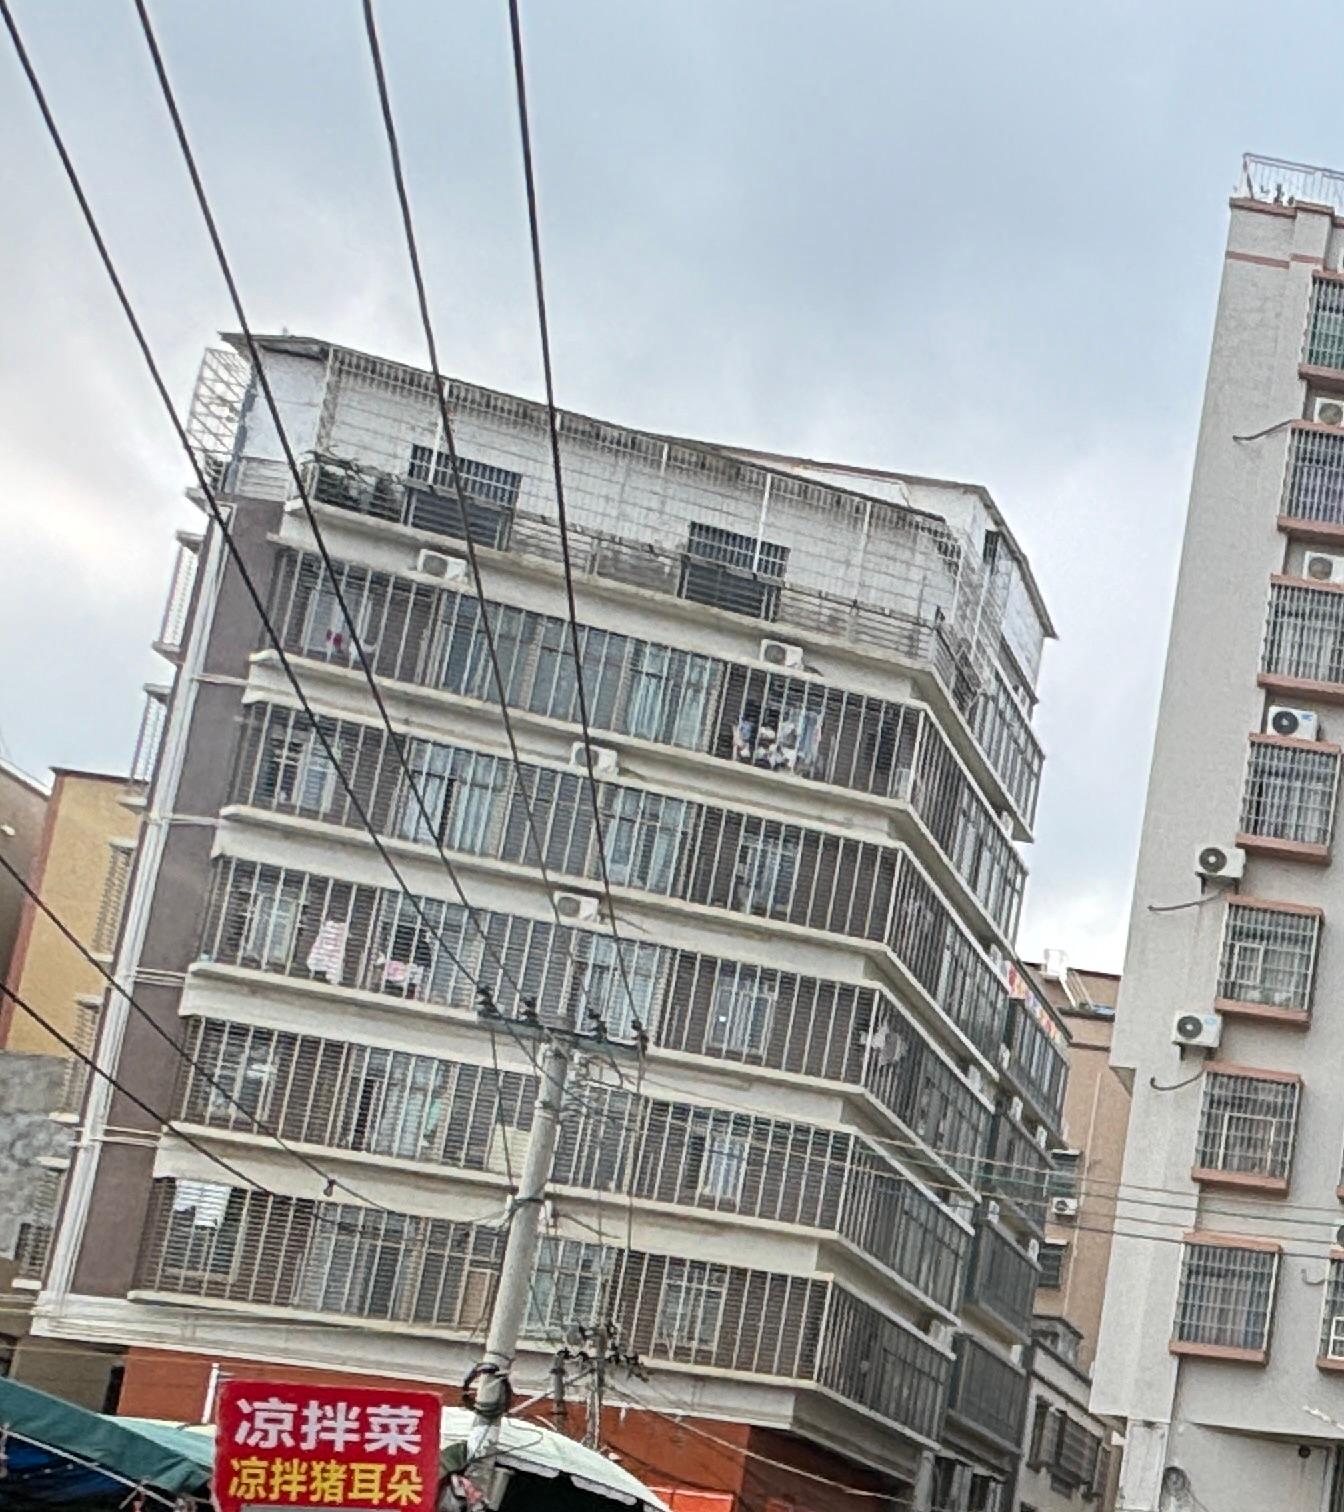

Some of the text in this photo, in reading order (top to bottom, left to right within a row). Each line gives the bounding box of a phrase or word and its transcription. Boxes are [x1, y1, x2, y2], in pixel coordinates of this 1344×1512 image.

[234, 1396, 424, 1455] 凉拌菜
[228, 1456, 424, 1506] 凉拌猪耳朵
